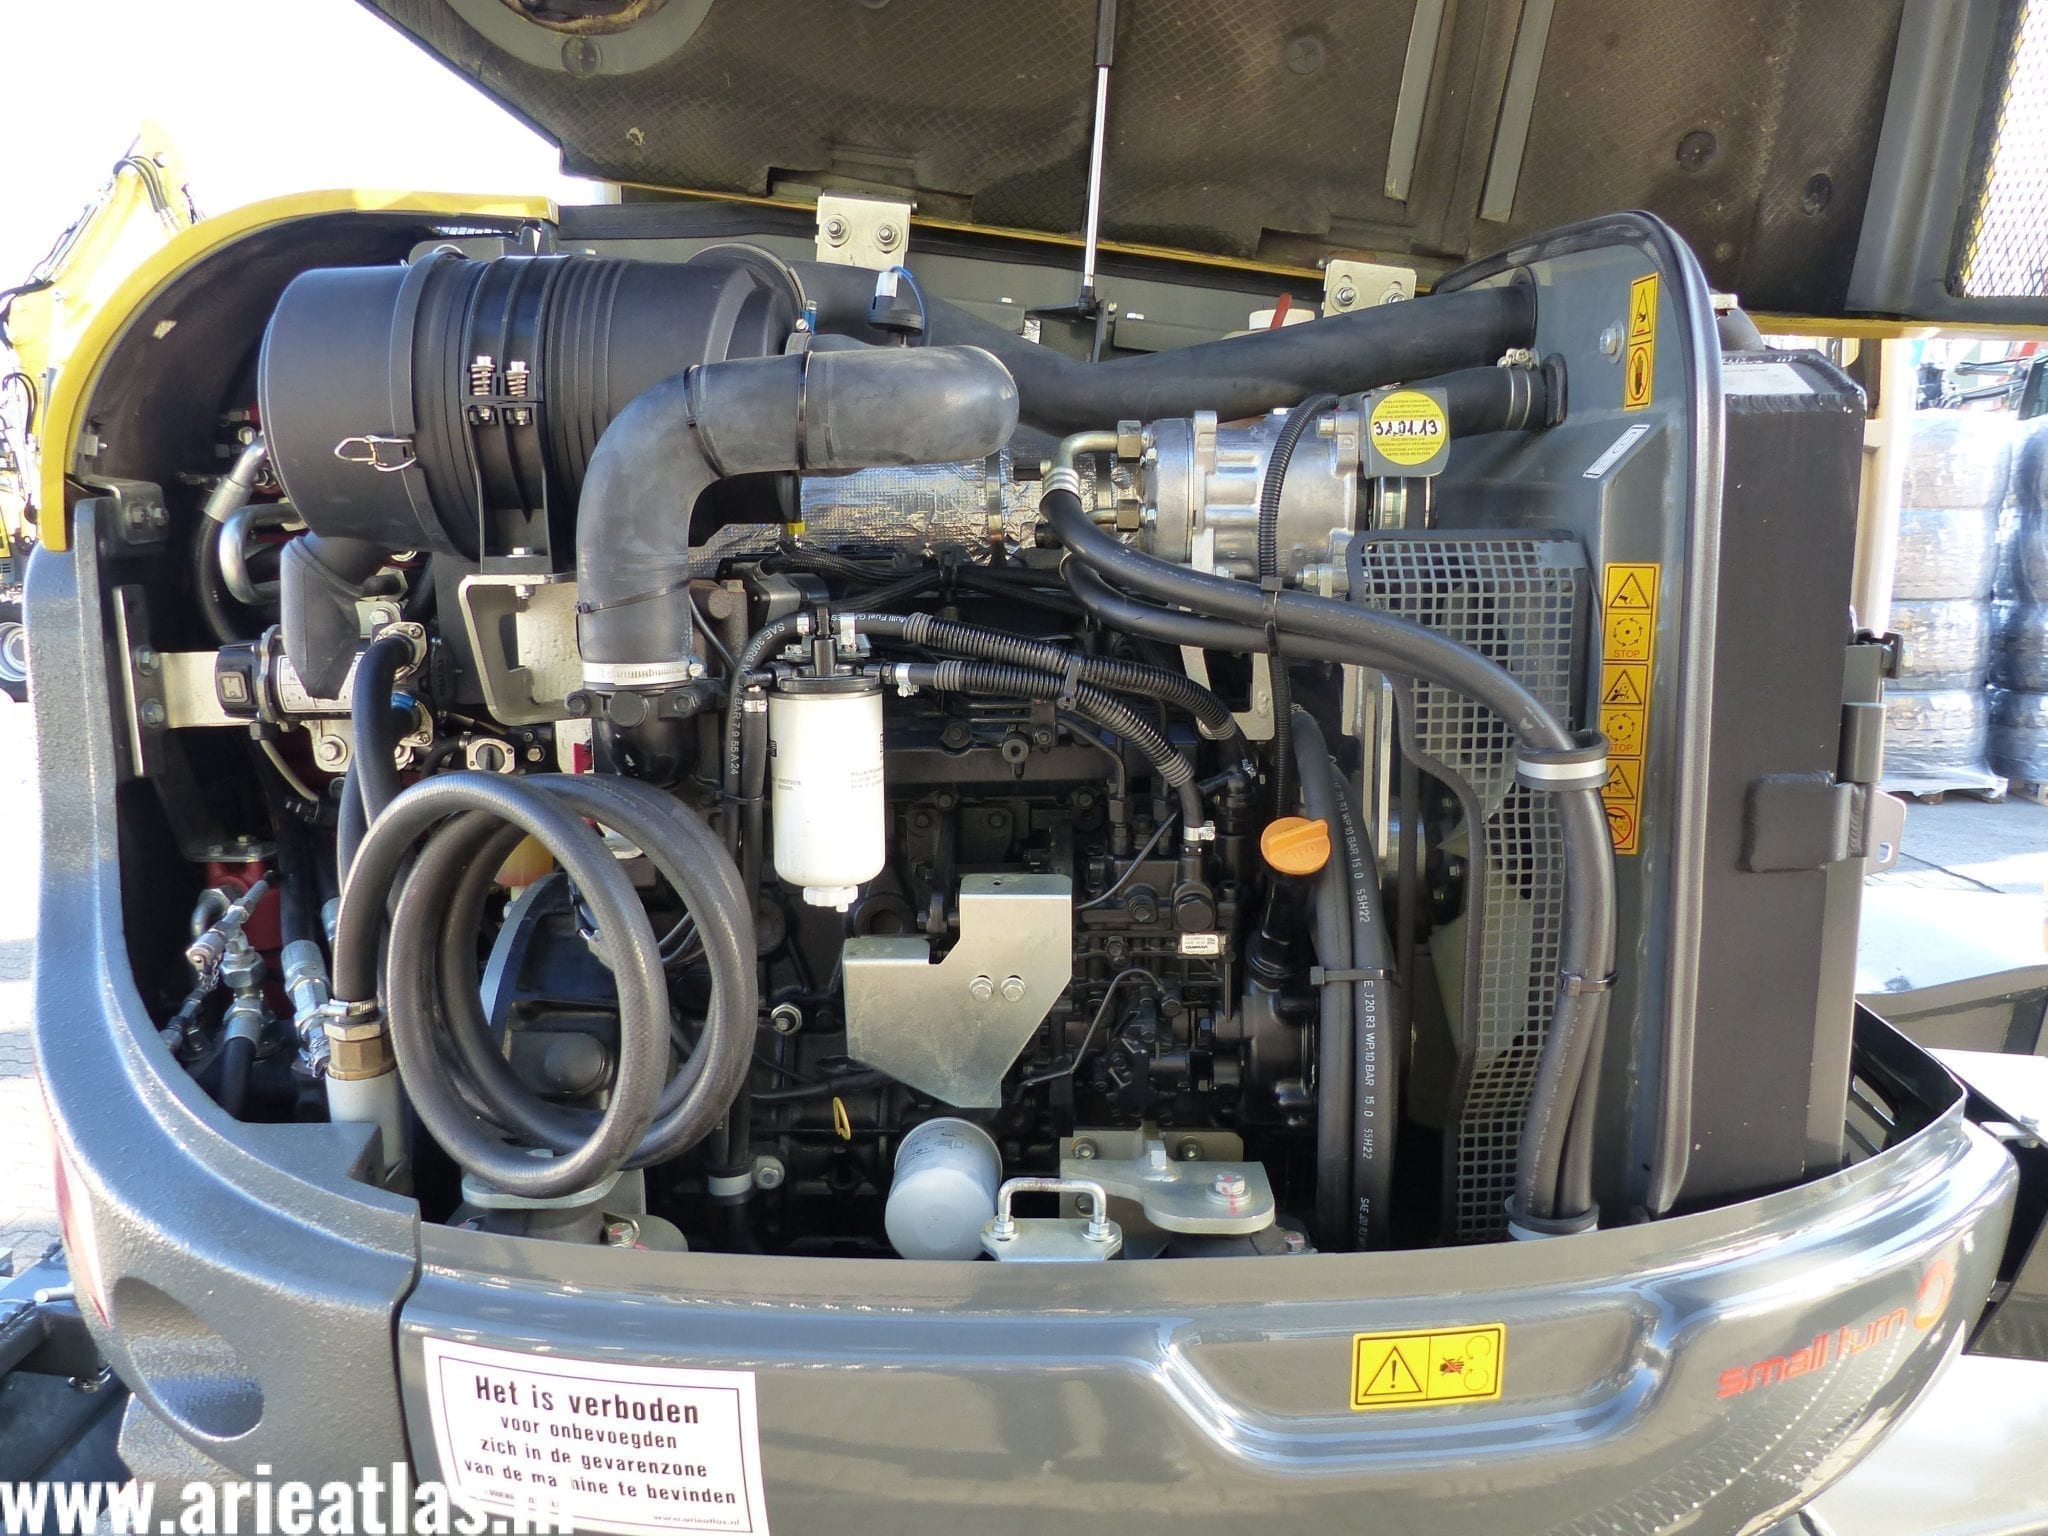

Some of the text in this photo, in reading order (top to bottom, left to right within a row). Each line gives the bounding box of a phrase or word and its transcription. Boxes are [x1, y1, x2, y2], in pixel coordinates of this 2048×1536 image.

[868, 613, 888, 622] Fuel
[763, 622, 785, 640] SAE
[745, 637, 765, 663] 30R6
[1614, 649, 1641, 659] STOP
[732, 698, 743, 720] BAR
[1607, 743, 1634, 752] STOP
[1346, 836, 1359, 856] BAR
[1364, 992, 1375, 1012] J20
[1365, 1015, 1376, 1029] R3
[1364, 1064, 1375, 1087] BAR
[1362, 1128, 1373, 1160] 55H22
[1359, 1197, 1370, 1214] SAE
[1716, 1307, 1907, 1400] small turn
[475, 1375, 699, 1424] Het is verboden
[500, 1416, 678, 1449] voor onbevoegden
[480, 1436, 708, 1478] zich in de gevarenzone
[464, 1459, 737, 1505] van de mahine te bevinden
